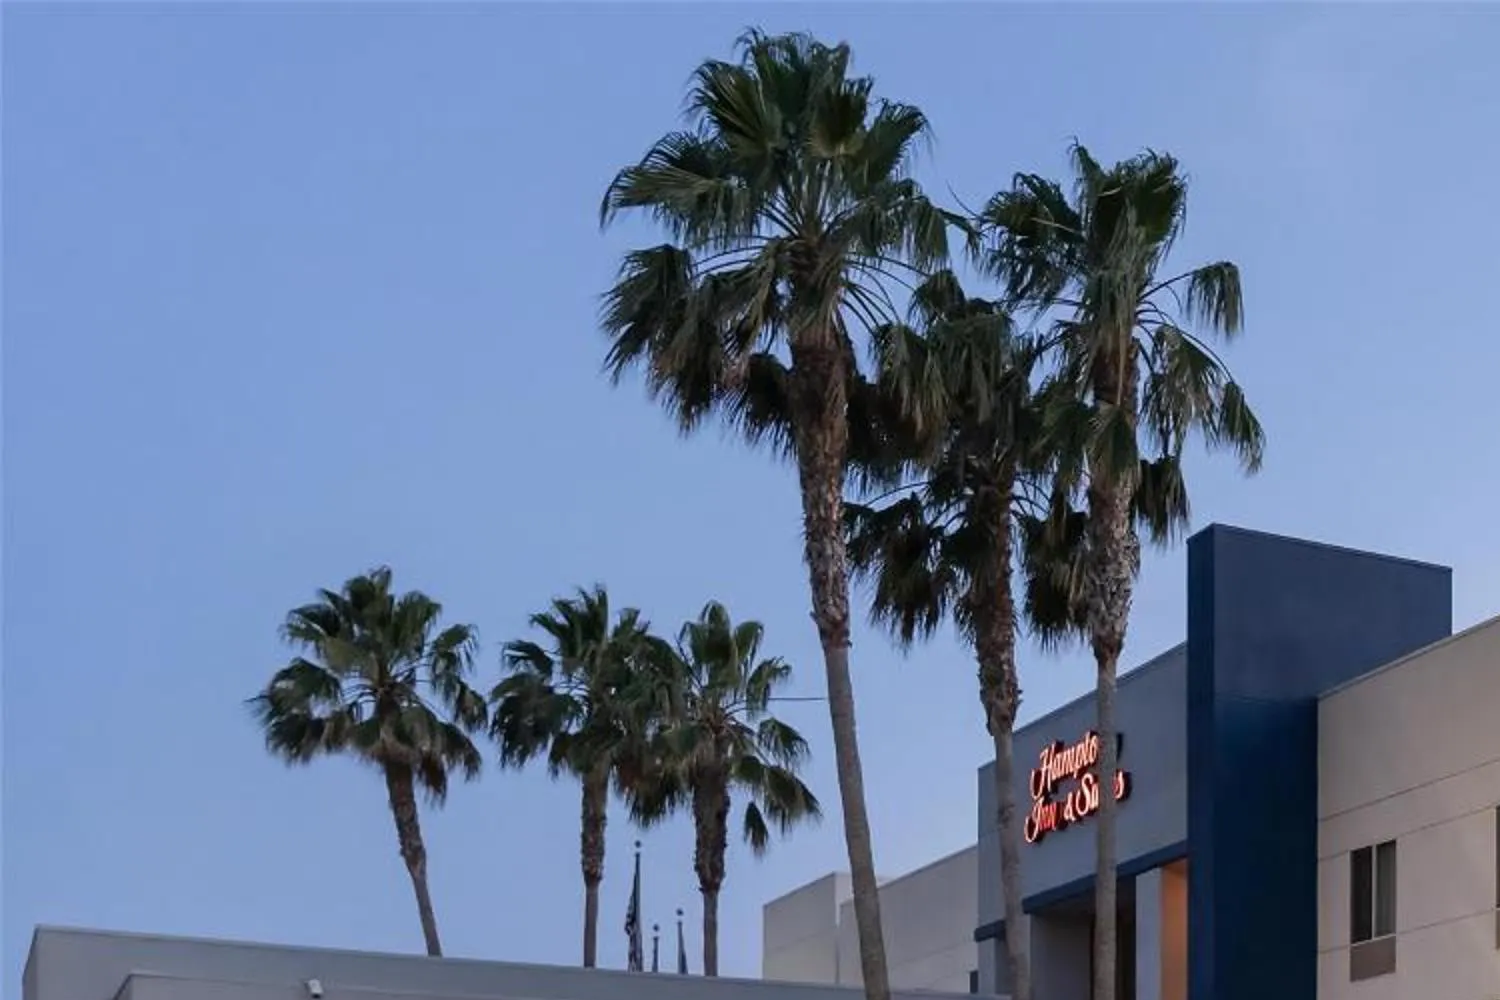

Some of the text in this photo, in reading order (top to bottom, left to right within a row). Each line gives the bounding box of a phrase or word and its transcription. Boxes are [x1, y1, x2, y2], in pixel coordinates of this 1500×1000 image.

[1030, 731, 1102, 799] Hampto
[1025, 796, 1058, 842] Inn
[1076, 774, 1125, 816] Sus
